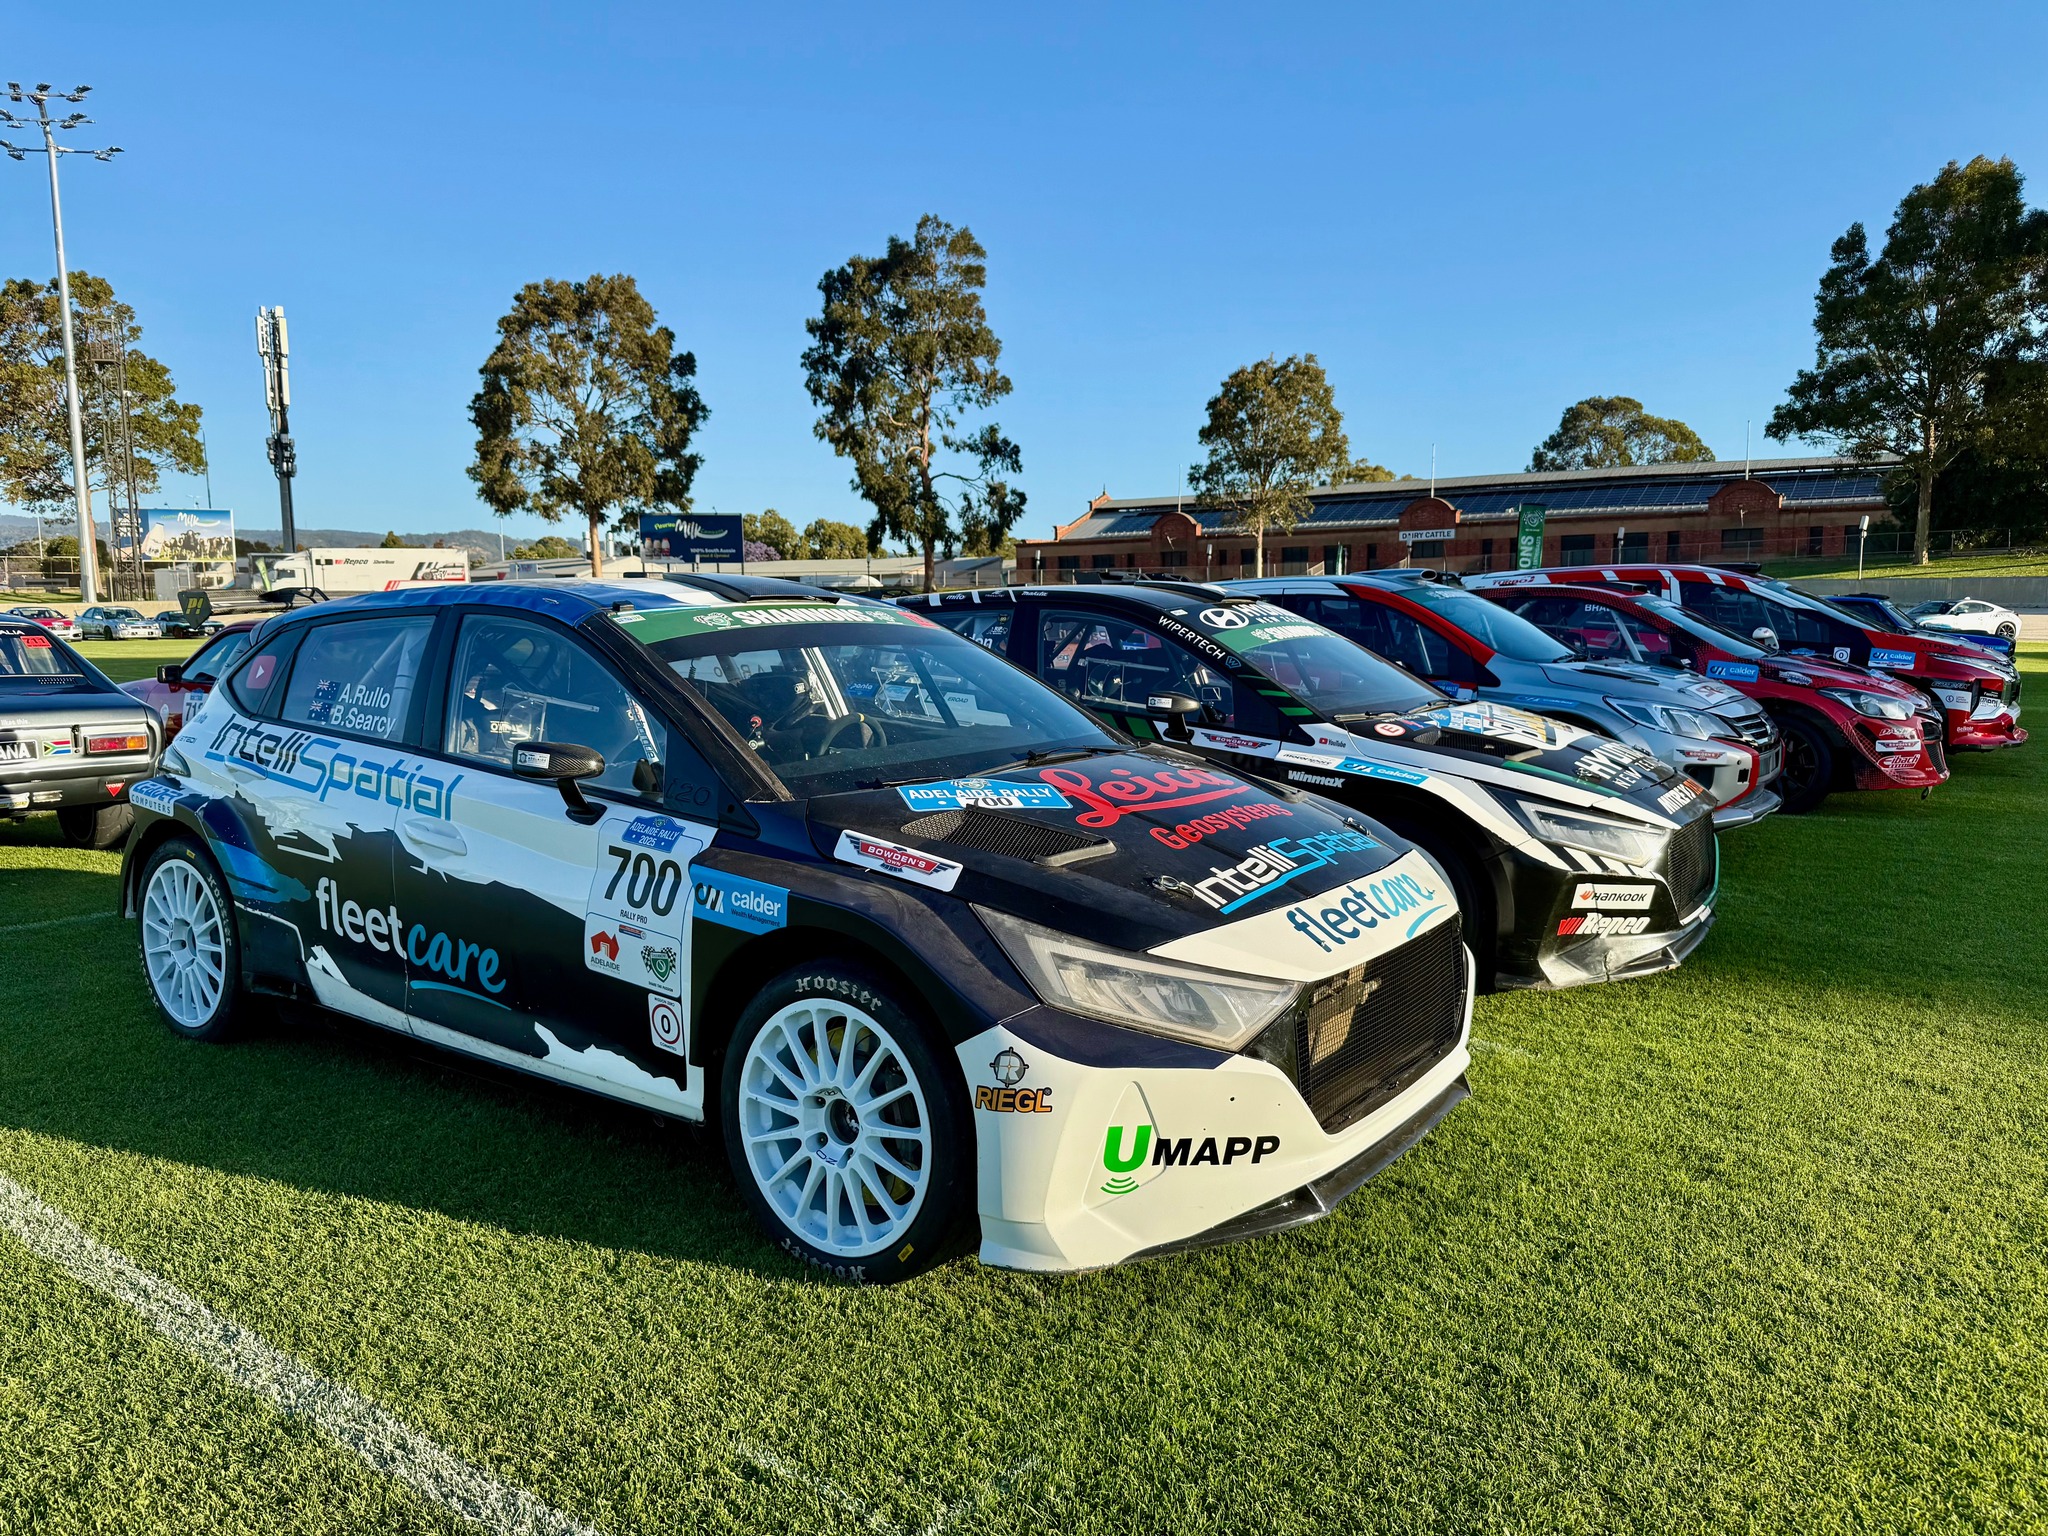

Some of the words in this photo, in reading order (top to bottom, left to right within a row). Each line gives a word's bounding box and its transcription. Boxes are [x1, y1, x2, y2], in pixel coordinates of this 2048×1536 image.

[675, 519, 712, 539] Milk
[1425, 530, 1452, 538] CATTLE
[343, 557, 369, 566] Repco
[731, 607, 875, 625] SHANNONS
[1157, 615, 1226, 660] WIPERTECH
[1890, 653, 1913, 661] calder
[1729, 667, 1756, 676] calder
[338, 682, 392, 709] A.Rullo
[330, 704, 397, 739] B.Searcy
[1328, 738, 1347, 749] YouTube
[205, 713, 465, 821] IntelliSpatial
[1376, 768, 1423, 782] calder
[1612, 768, 1643, 790] NEW
[908, 787, 995, 800] ADELAIDE
[997, 787, 1053, 799] RALLY
[970, 796, 1014, 808] 700
[1038, 768, 1246, 828] Leica
[131, 793, 171, 815] COMPUTERS
[629, 821, 658, 837] ADELAIDE
[658, 827, 681, 841] RALLY
[1149, 801, 1294, 850] Geosystems
[638, 835, 657, 847] 2025
[867, 845, 926, 868] BOWDEN'S
[604, 844, 682, 917] 700
[731, 890, 782, 917] calder
[1286, 872, 1436, 953] fleetcare
[619, 909, 636, 921] RALLY
[636, 914, 648, 924] PRO
[731, 908, 747, 920] Wealth
[747, 912, 781, 927] Management
[1574, 912, 1651, 939] Repco
[316, 876, 507, 994] fleetcare
[590, 956, 621, 971] ADELAIDE
